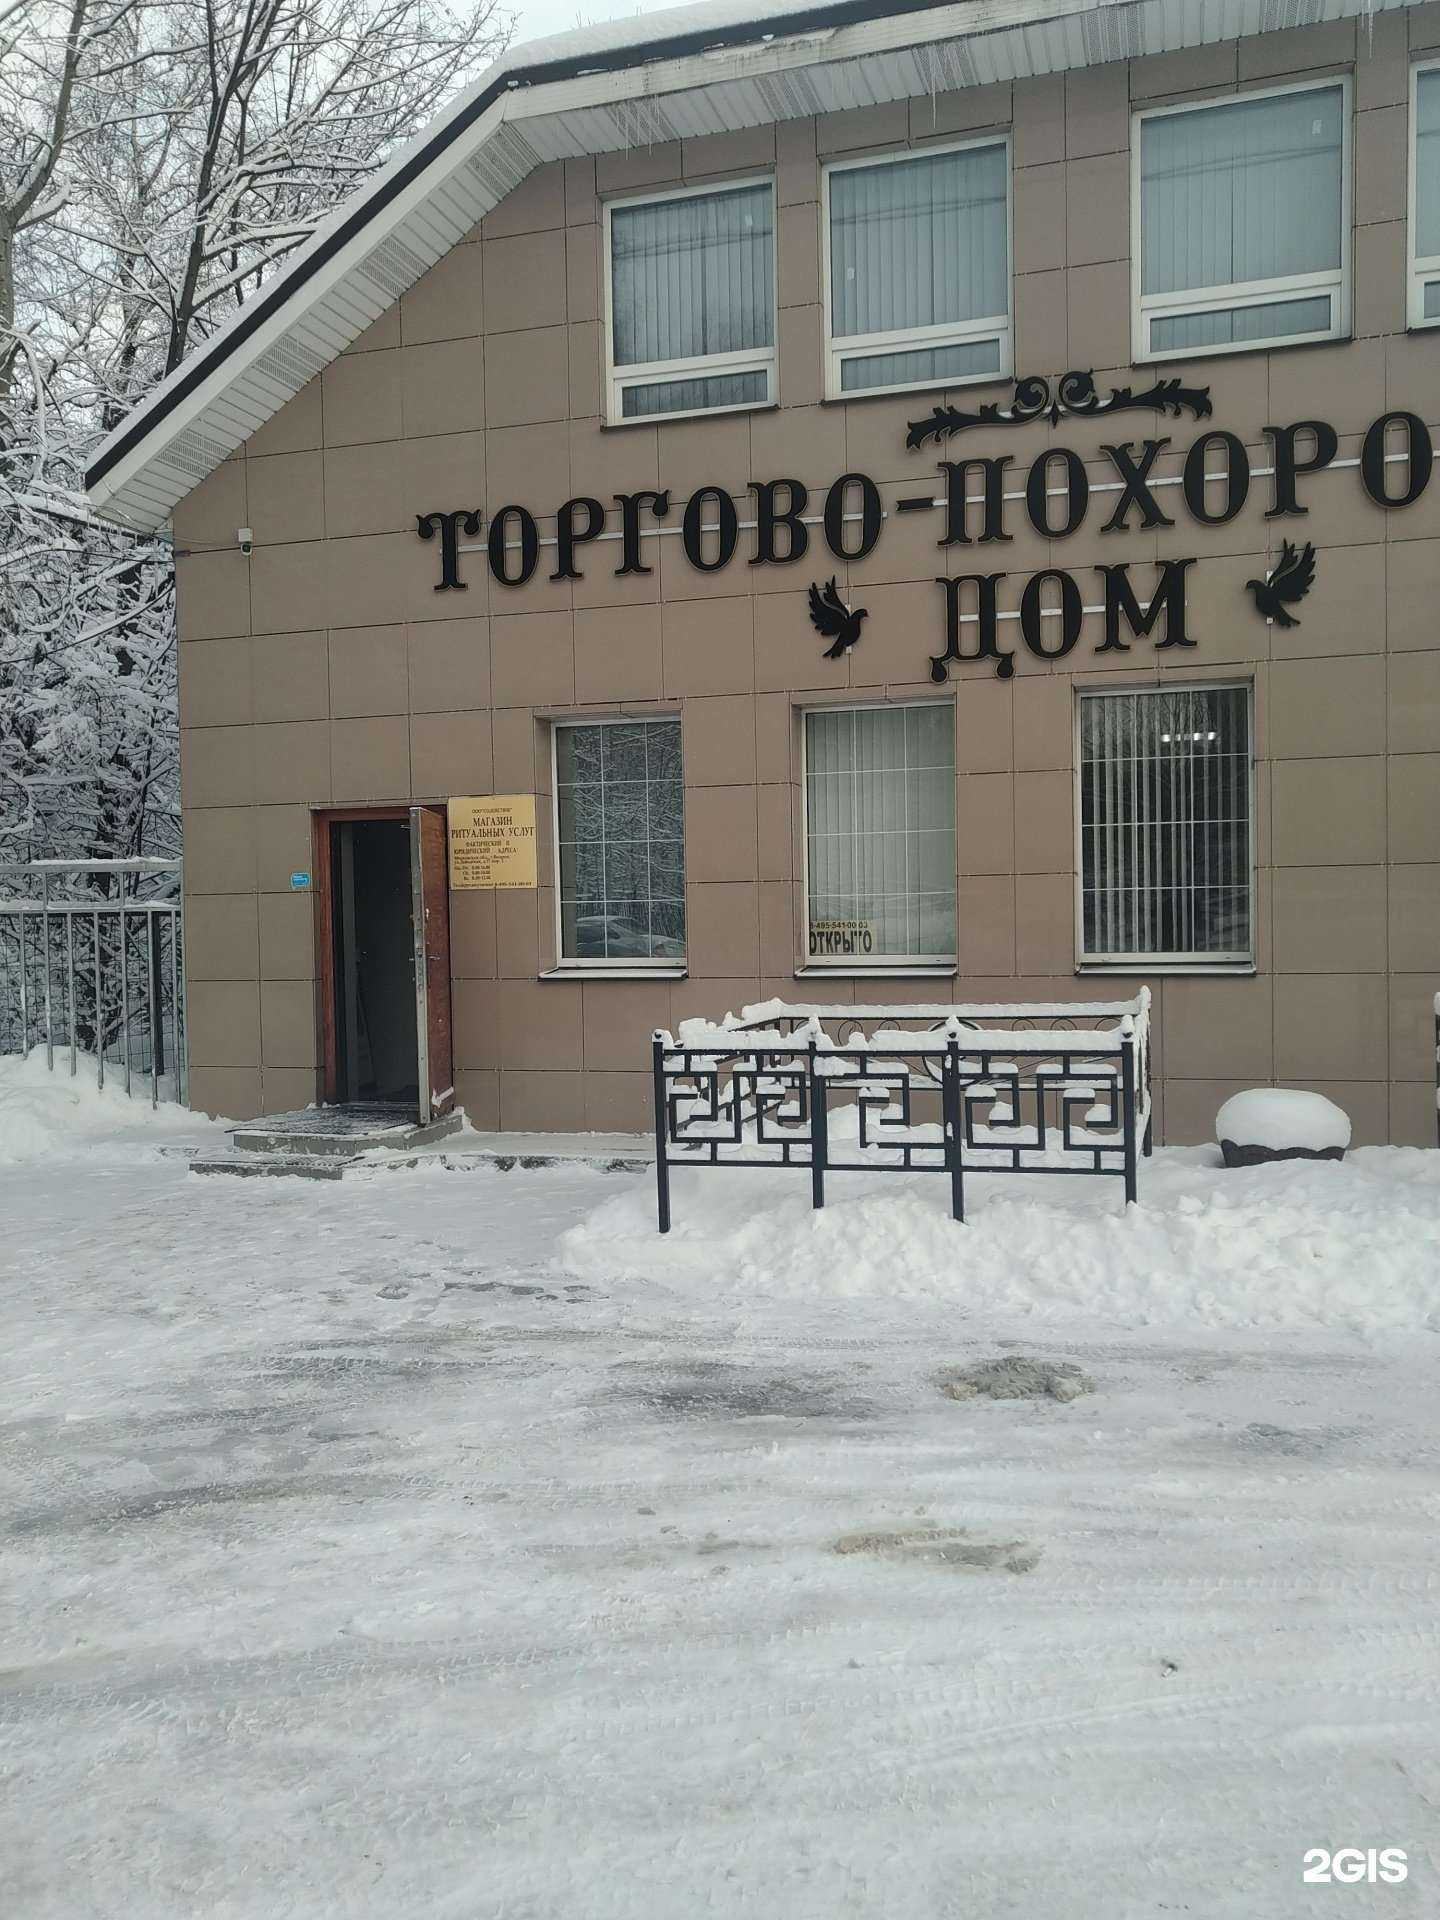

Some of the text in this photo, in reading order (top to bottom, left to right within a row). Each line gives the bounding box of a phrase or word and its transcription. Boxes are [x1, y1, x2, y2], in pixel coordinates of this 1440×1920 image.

[929, 557, 1197, 683] ДОМ
[473, 816, 512, 826] МАГАЗИН
[451, 827, 534, 838] РИТУАЛЬНЫХ УСЛУГ
[809, 930, 873, 953] ОТКРЫТО
